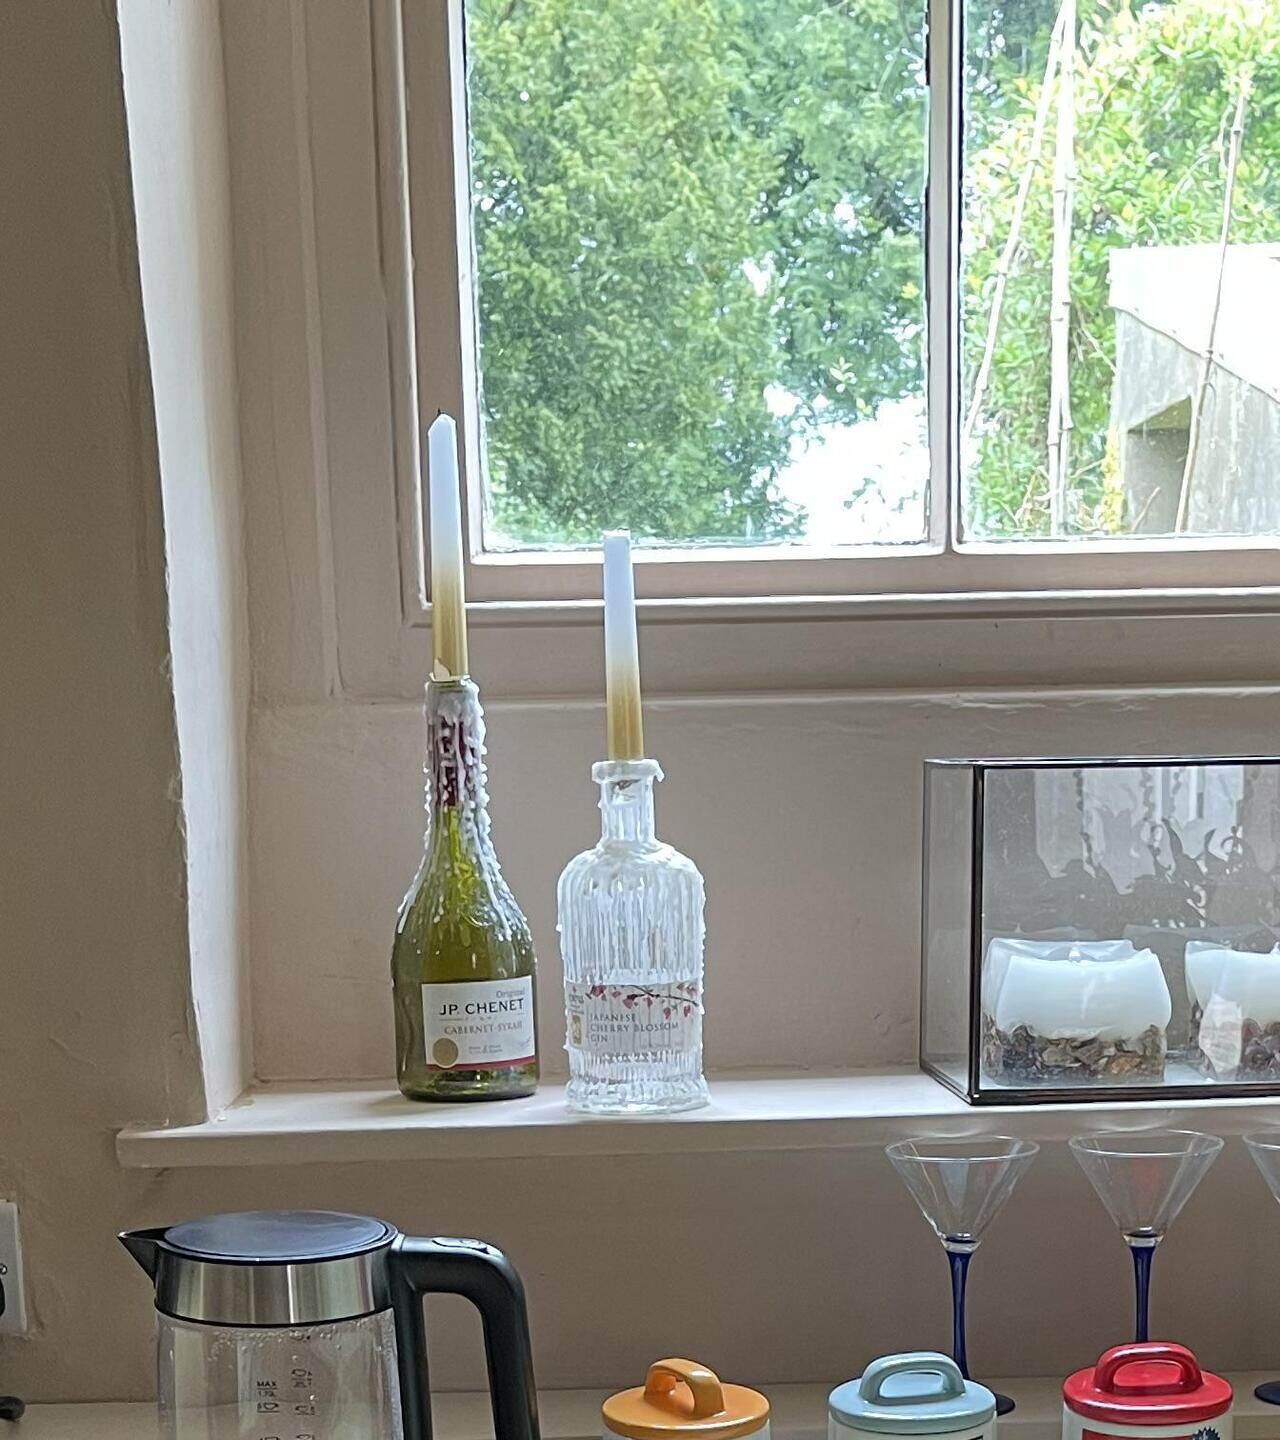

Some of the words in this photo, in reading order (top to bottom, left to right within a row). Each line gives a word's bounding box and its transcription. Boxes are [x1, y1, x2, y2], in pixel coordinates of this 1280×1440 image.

[465, 998, 525, 1015] CHENET
[590, 1013, 637, 1022] JAPANESE
[590, 1024, 630, 1033] CHERRY
[634, 1022, 679, 1032] BLOSSOM
[590, 1034, 608, 1043] GIN
